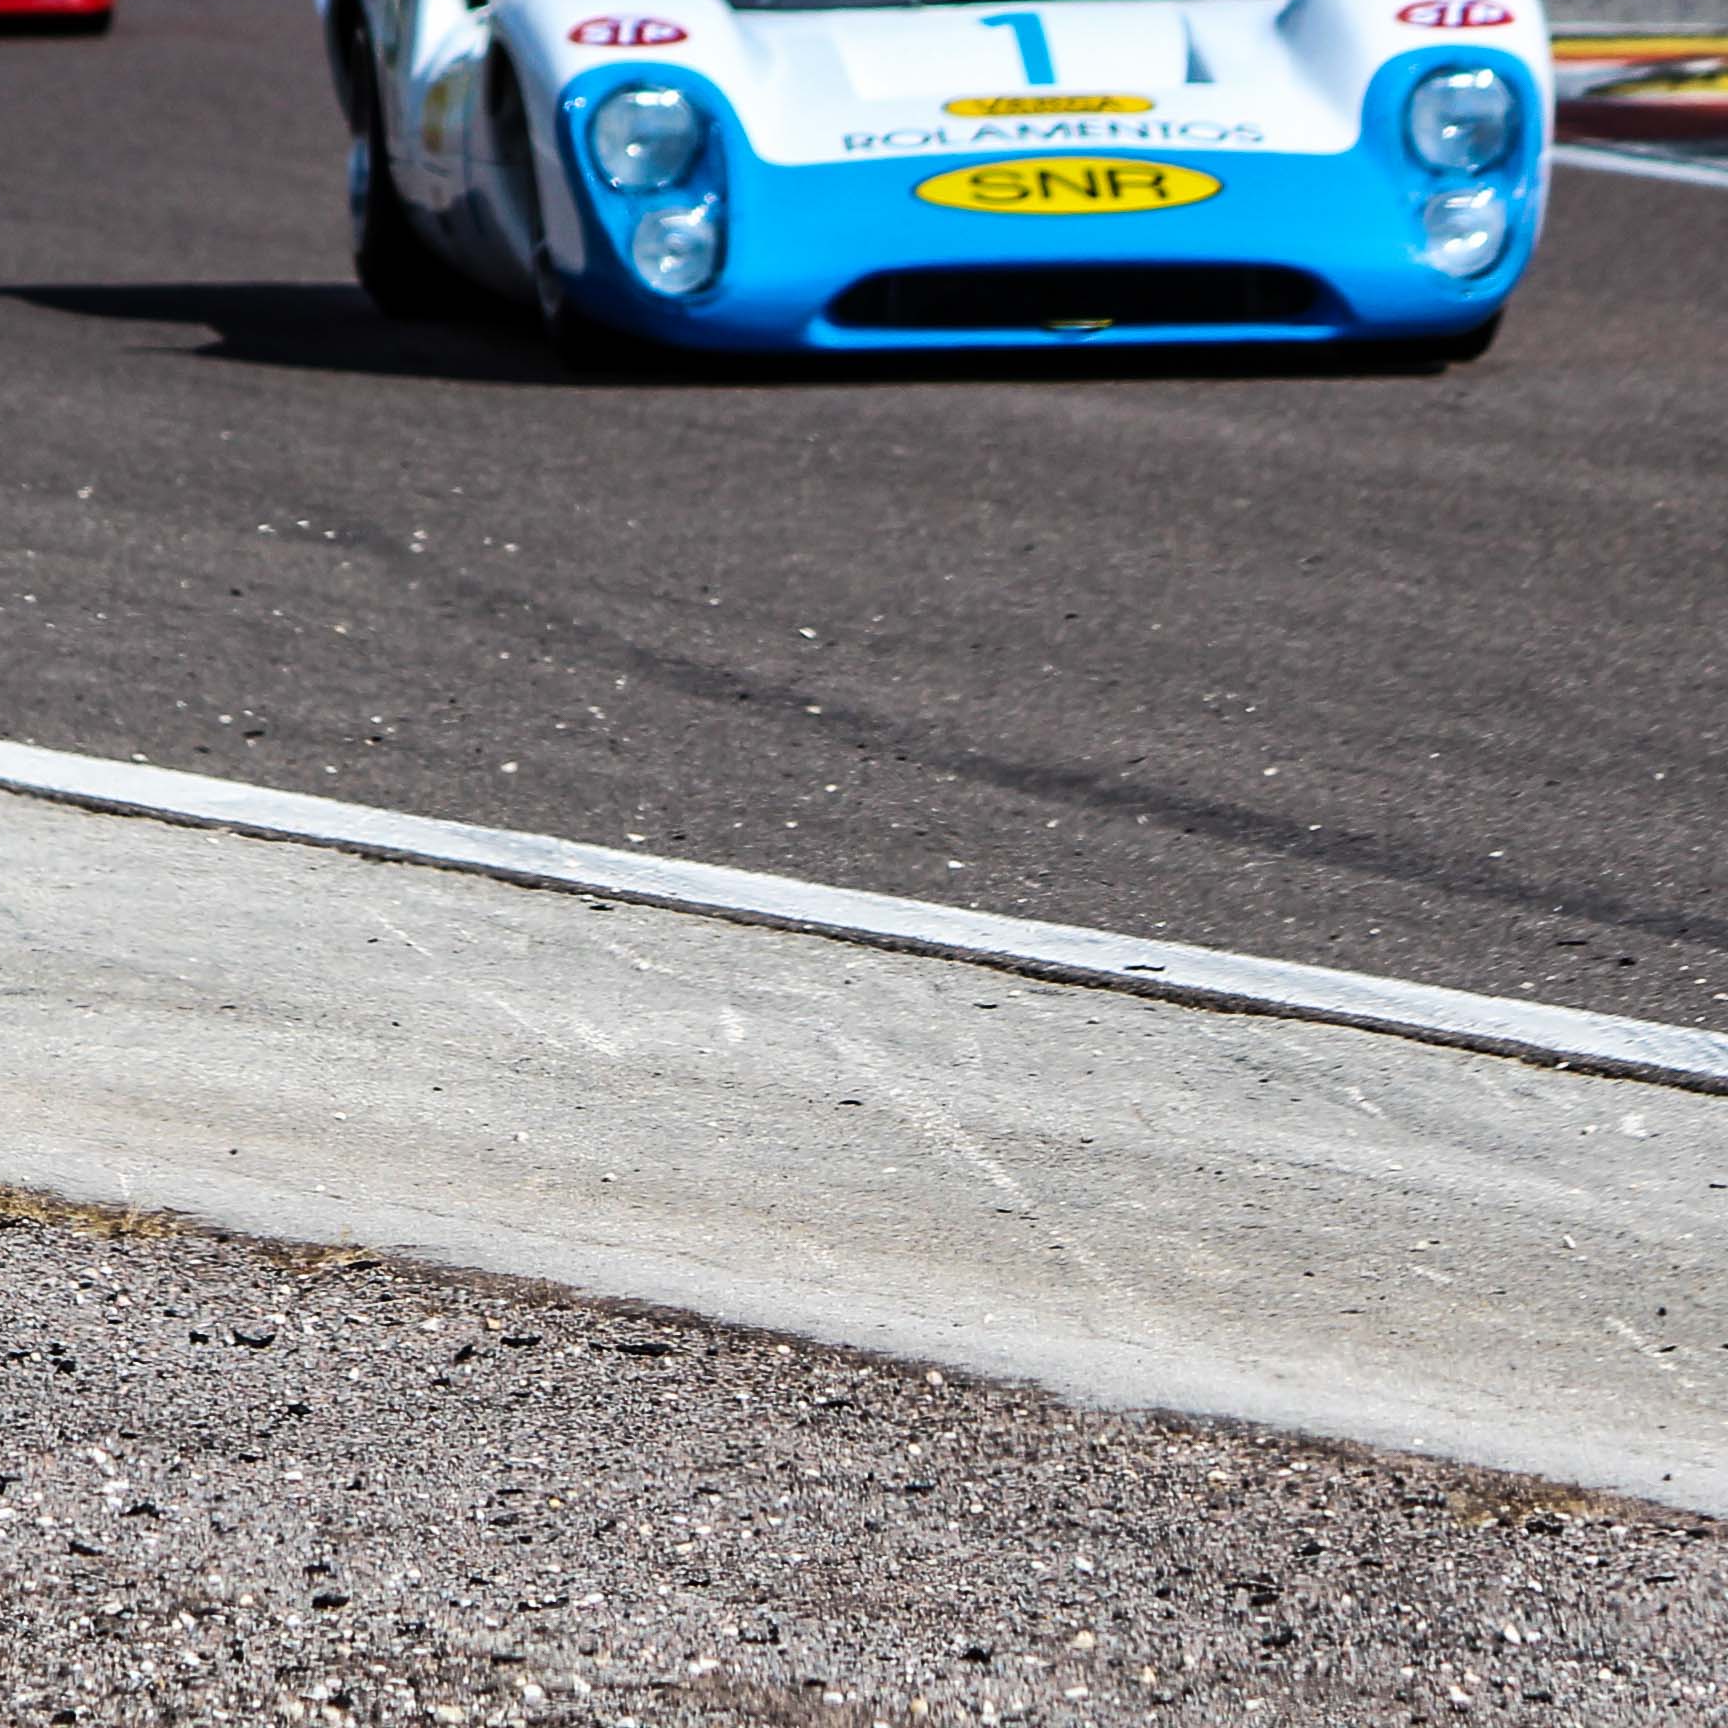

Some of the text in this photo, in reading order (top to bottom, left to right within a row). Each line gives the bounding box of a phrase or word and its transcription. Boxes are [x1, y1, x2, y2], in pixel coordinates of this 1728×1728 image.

[1408, 0, 1506, 26] STP
[580, 18, 678, 45] STP
[978, 11, 1056, 84] 1
[840, 118, 1265, 153] ROLAMENTOS
[968, 167, 1169, 205] SNR
